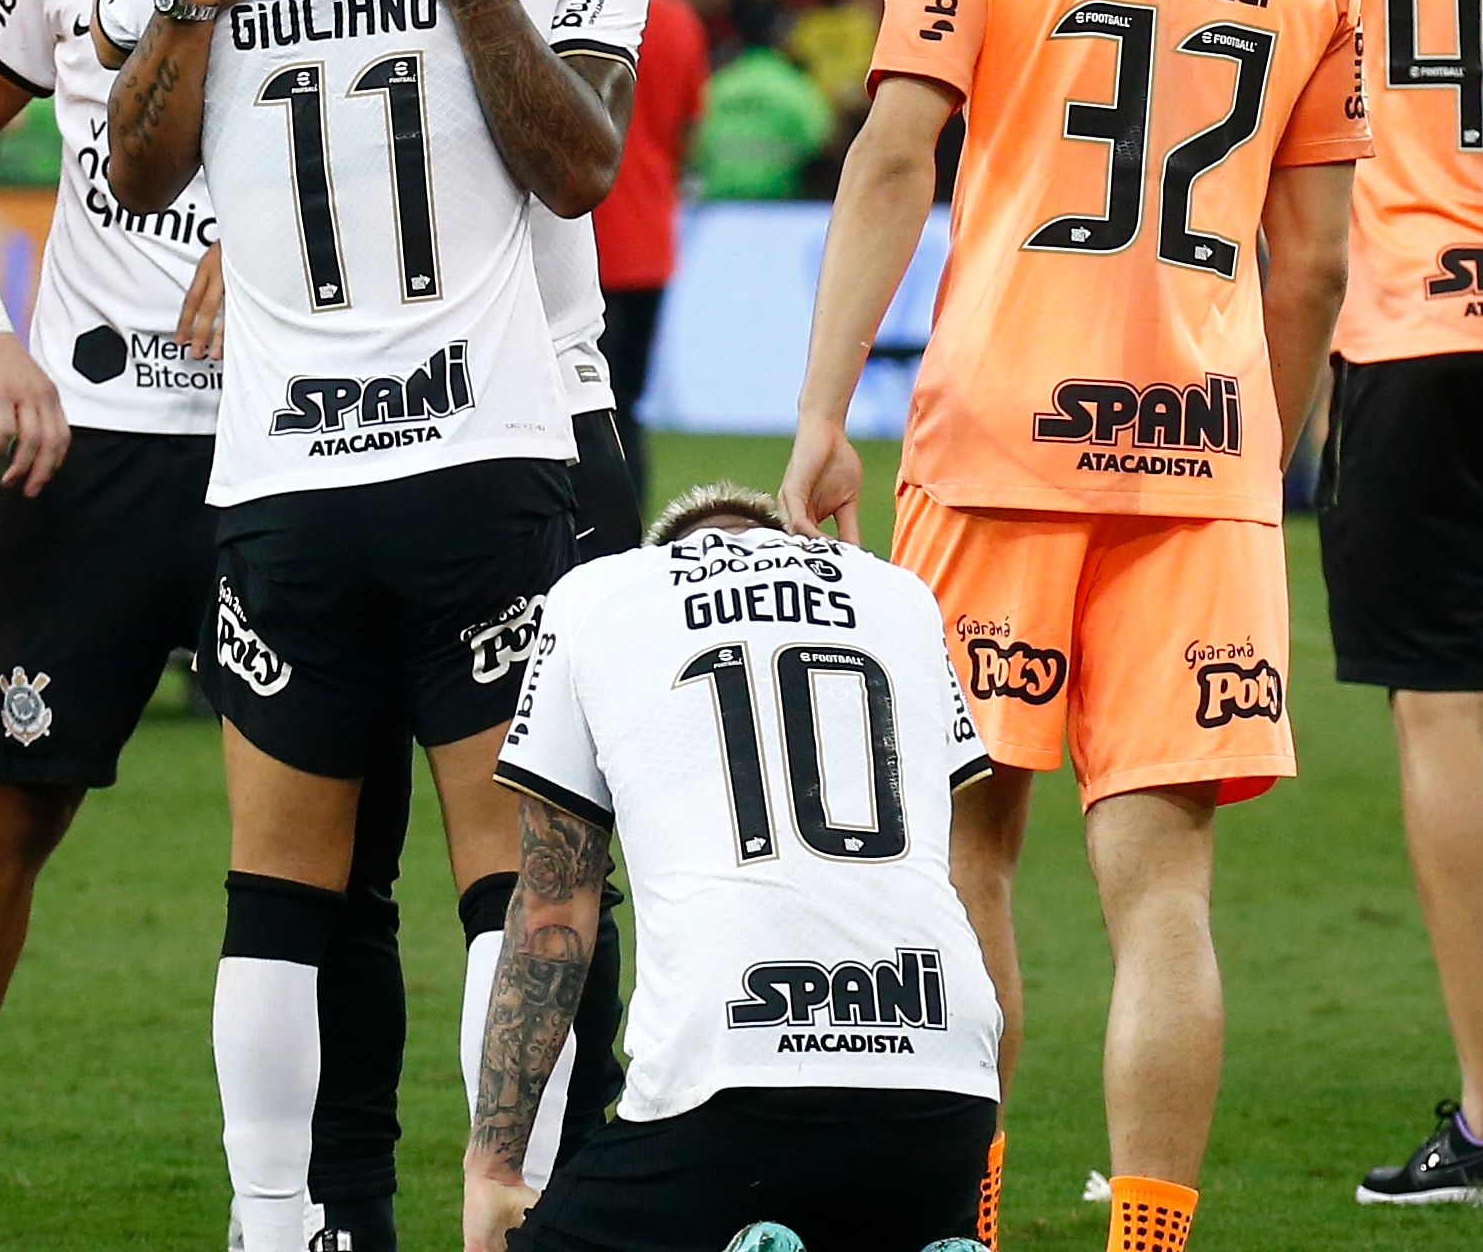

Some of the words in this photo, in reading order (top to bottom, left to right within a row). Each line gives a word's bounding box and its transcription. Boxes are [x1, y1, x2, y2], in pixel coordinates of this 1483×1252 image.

[254, 50, 443, 313] 11
[308, 425, 442, 457] ATACADISTA
[1076, 452, 1213, 479] ATACADISTA
[669, 559, 749, 586] TODO
[754, 556, 803, 573] DIA
[684, 581, 857, 631] GUEDES
[471, 595, 546, 683] Pot
[956, 614, 1011, 642] Guaraná
[968, 638, 1067, 705] Poty
[1184, 635, 1255, 669] Guaraná
[516, 633, 557, 719] bmg
[670, 640, 910, 867] 10
[777, 1034, 915, 1054] ATACADISTA
